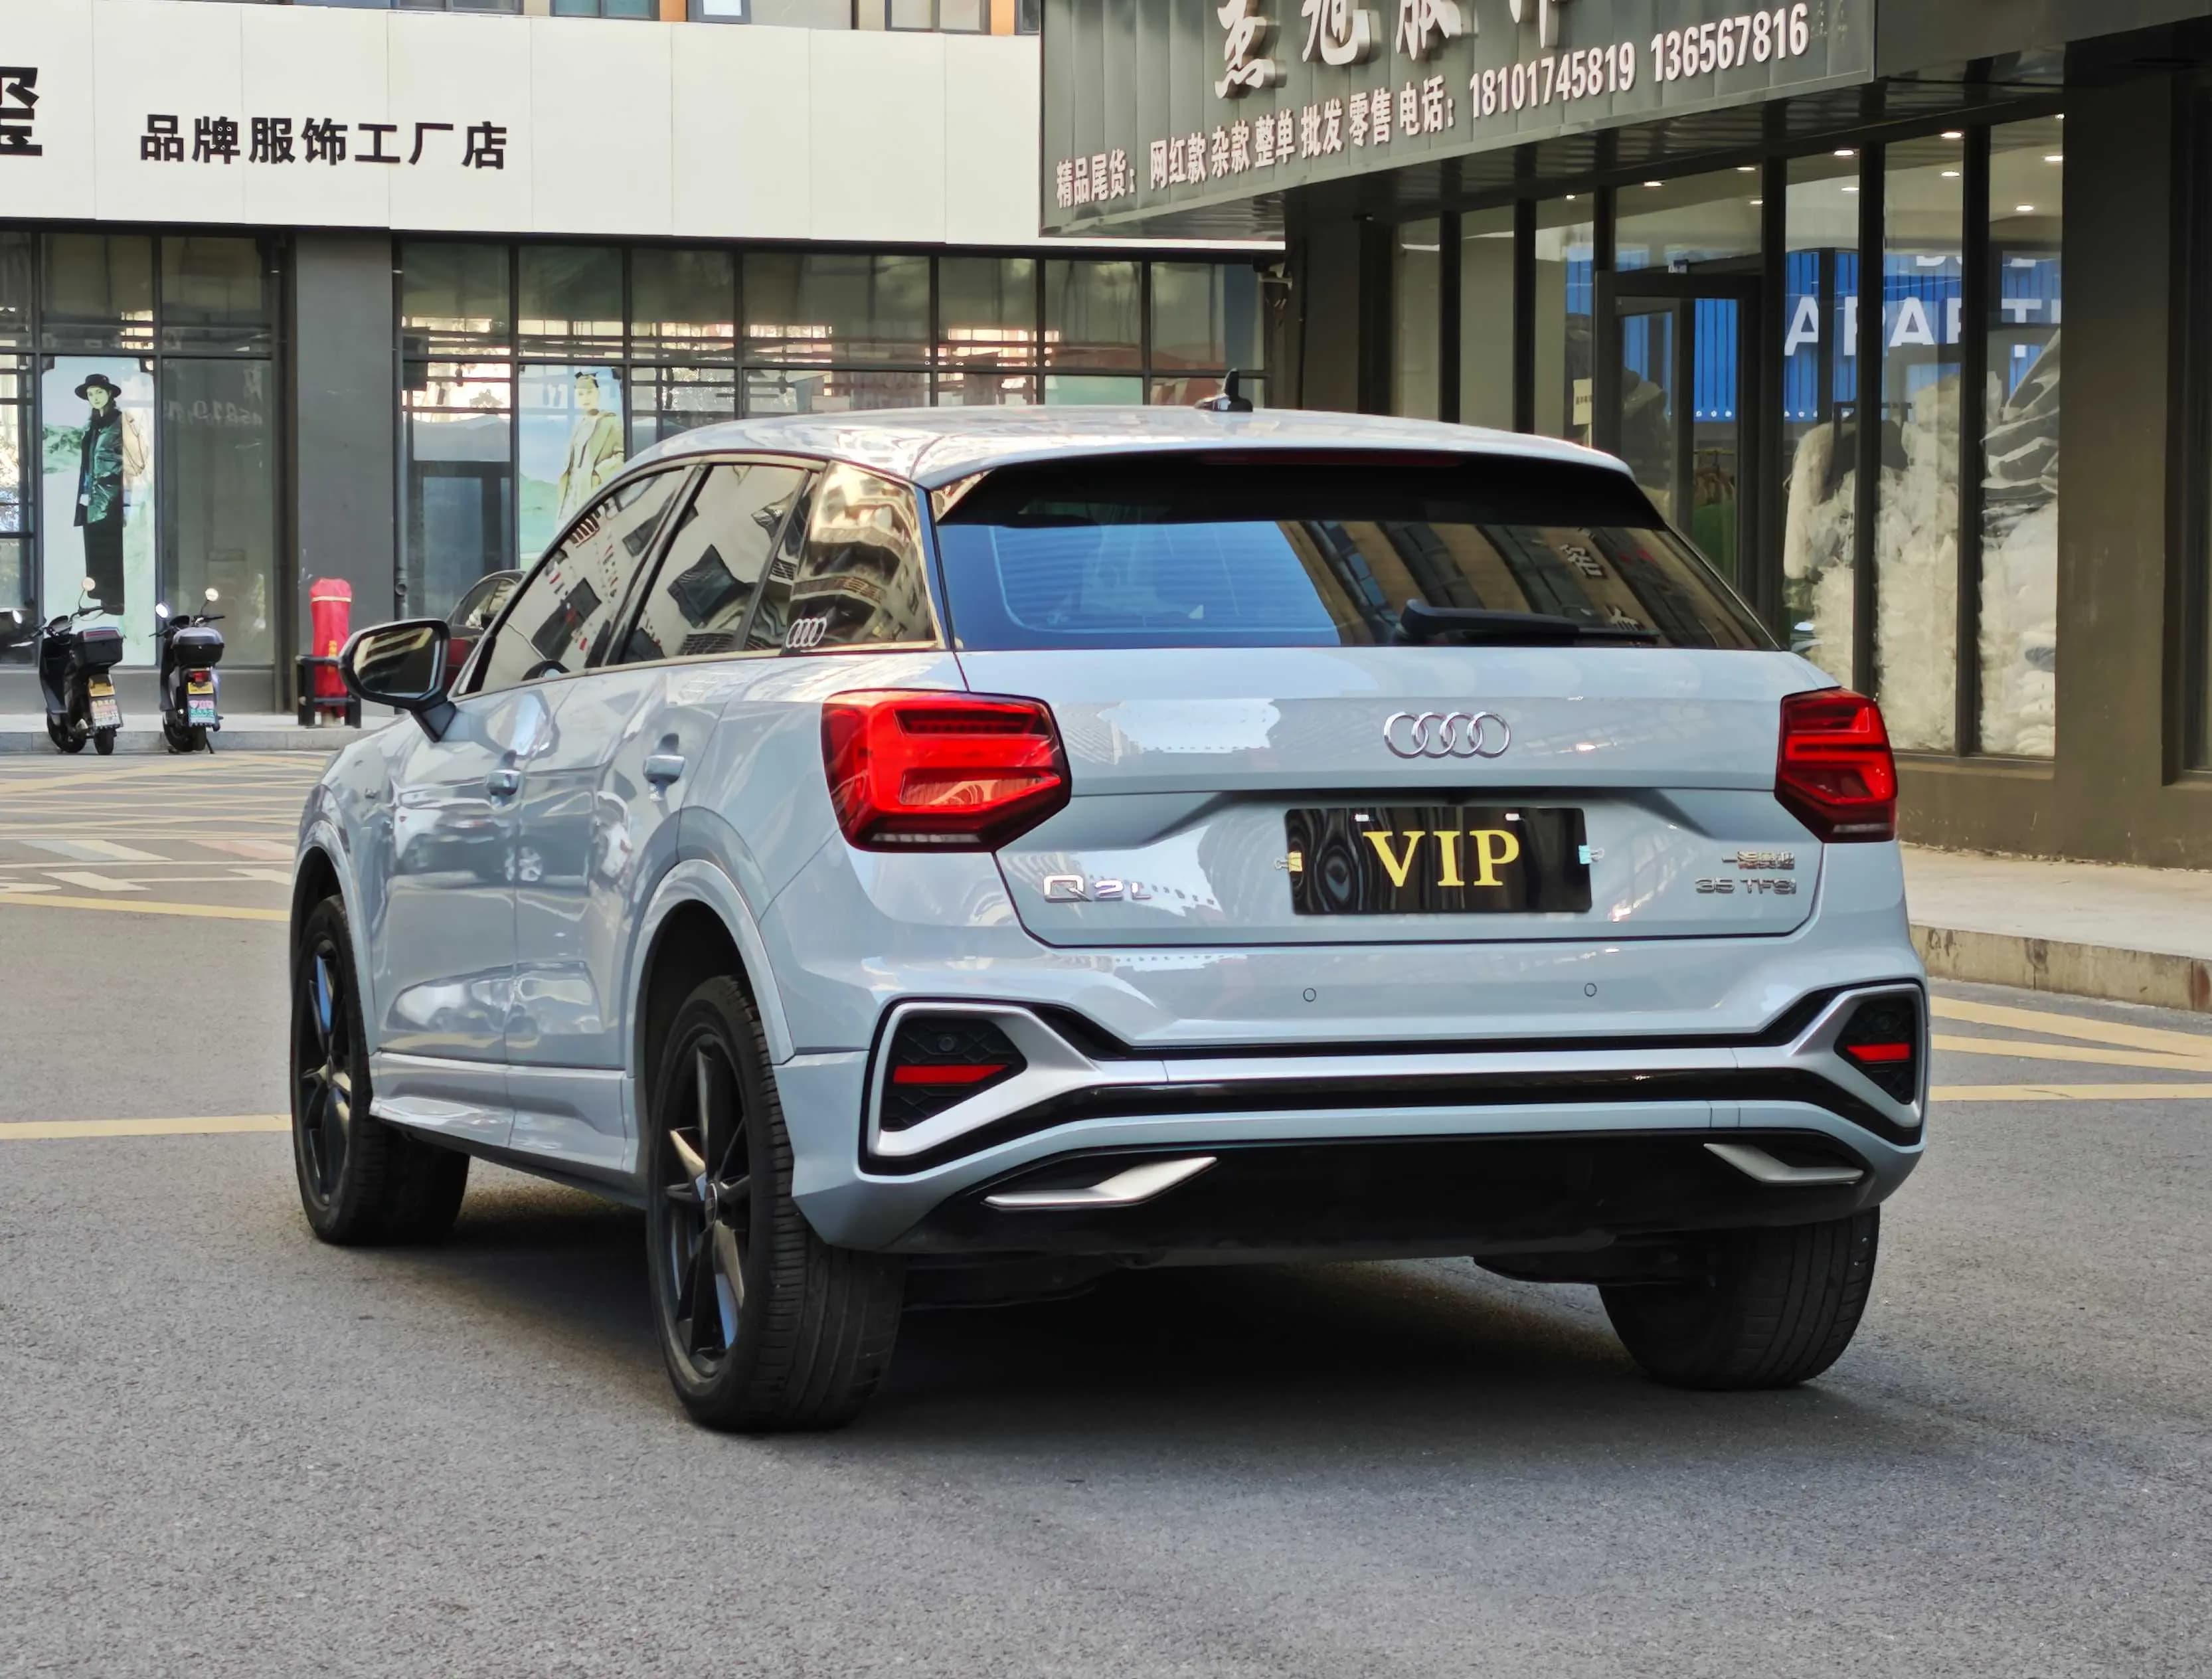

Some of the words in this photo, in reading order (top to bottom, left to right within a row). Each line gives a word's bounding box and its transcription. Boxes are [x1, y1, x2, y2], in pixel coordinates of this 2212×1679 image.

[1056, 148, 1136, 208] 精品尾货：
[1149, 132, 1207, 191] 网红款
[1211, 120, 1250, 179] 杂款
[1254, 108, 1296, 169] 整单
[1300, 98, 1343, 159] 批发
[1349, 87, 1393, 147] 零售
[1399, 74, 1454, 136] 电话：
[1469, 42, 1636, 118] 18101745819
[1650, 3, 1809, 82] 136567816
[140, 114, 507, 170] 品牌服饰工厂店
[1363, 829, 1520, 887] VIP
[1695, 878, 1735, 894] 35
[1043, 874, 1151, 903] Q2L
